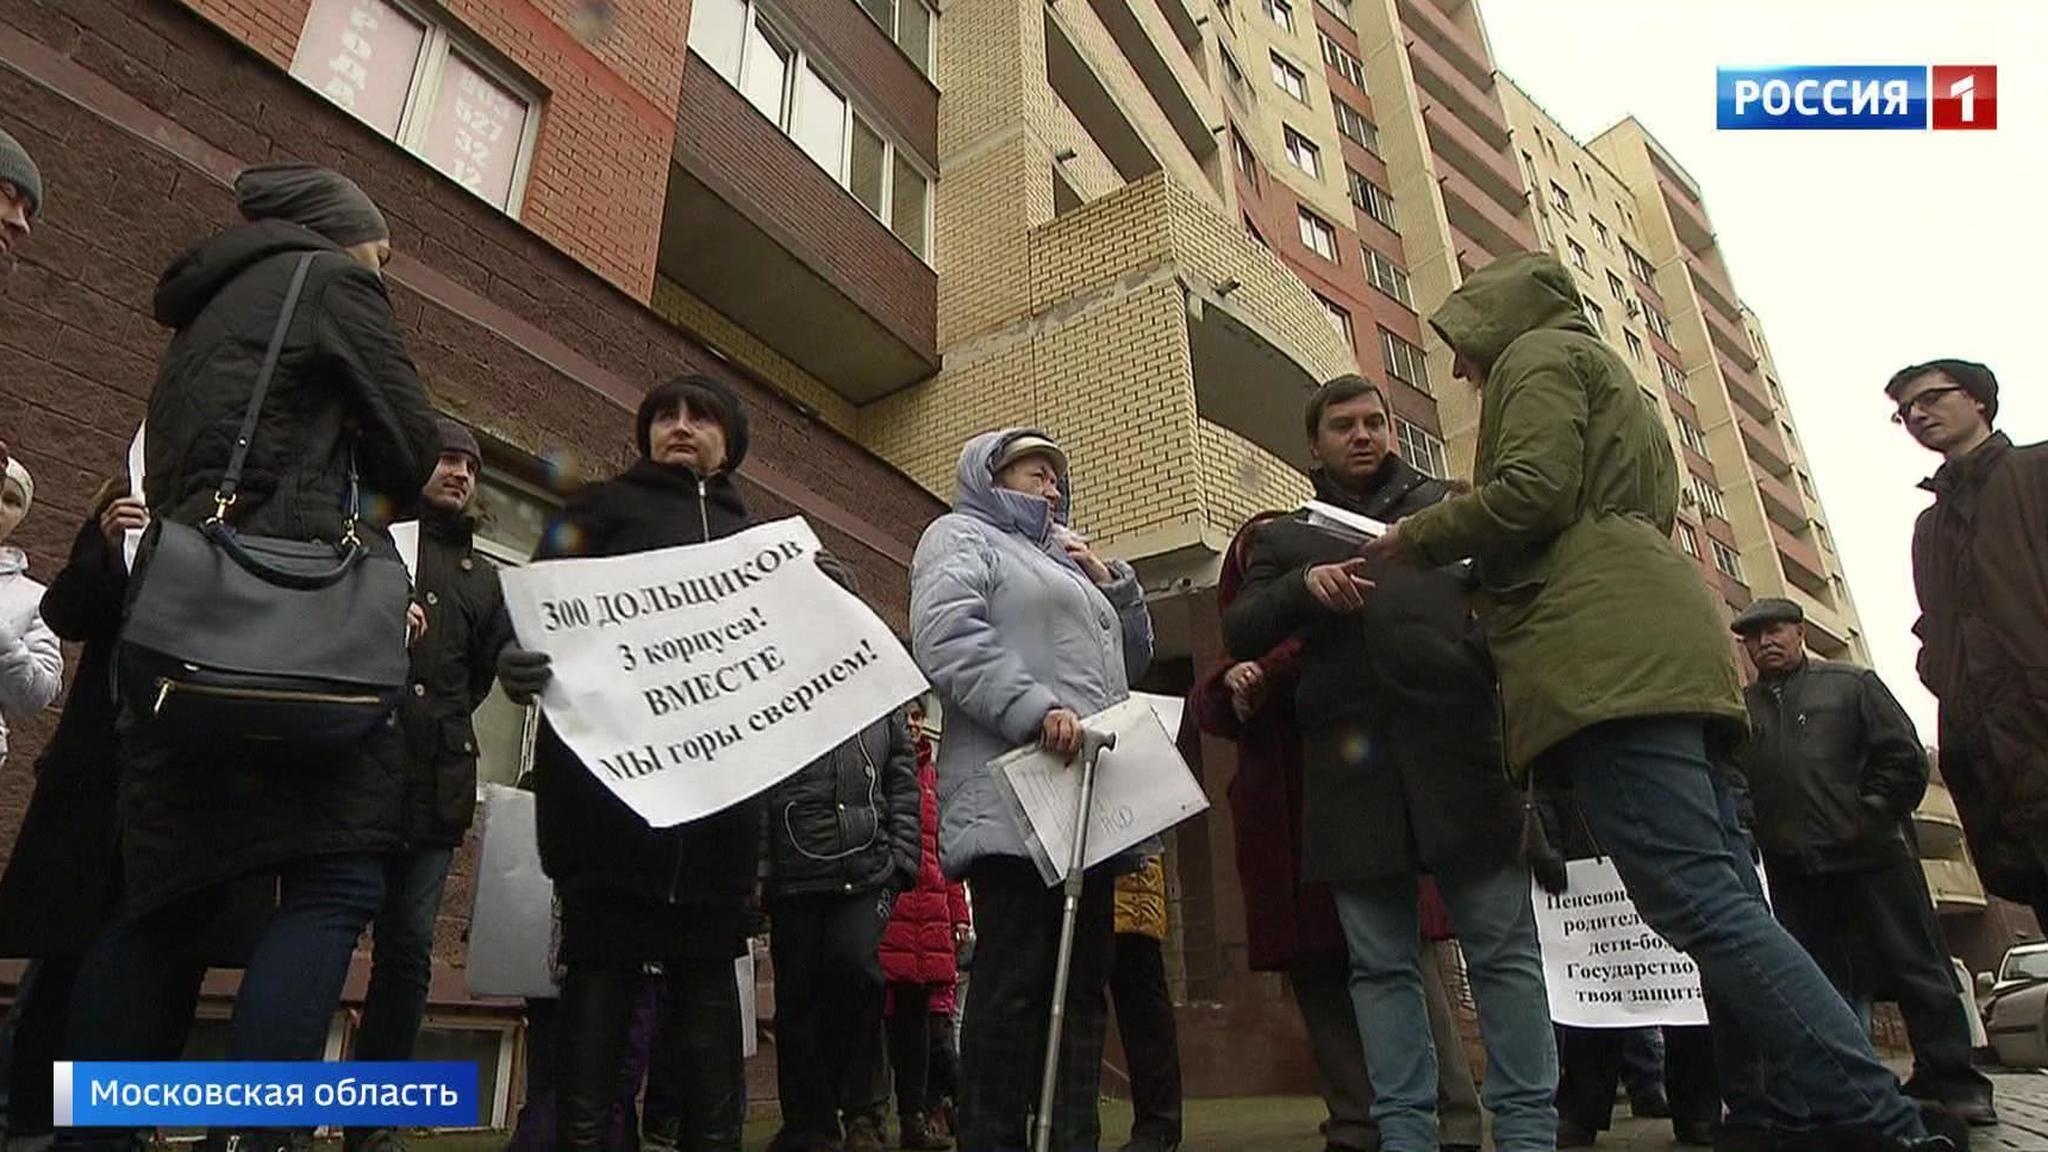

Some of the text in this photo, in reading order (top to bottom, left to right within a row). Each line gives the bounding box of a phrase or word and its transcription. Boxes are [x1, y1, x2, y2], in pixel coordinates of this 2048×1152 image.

[541, 540, 804, 632] 300 ДОЛЬЩИКОВ
[617, 606, 768, 672] 3 корпуса!
[642, 645, 785, 717] ВМЕСТЕ
[600, 638, 879, 782] МЫ горы свернем!
[1547, 889, 1626, 910] Пенсион
[1564, 912, 1641, 937] родител
[1589, 932, 1672, 956] дети-бо
[1567, 960, 1694, 983] Государство
[1576, 988, 1622, 1003] твоя
